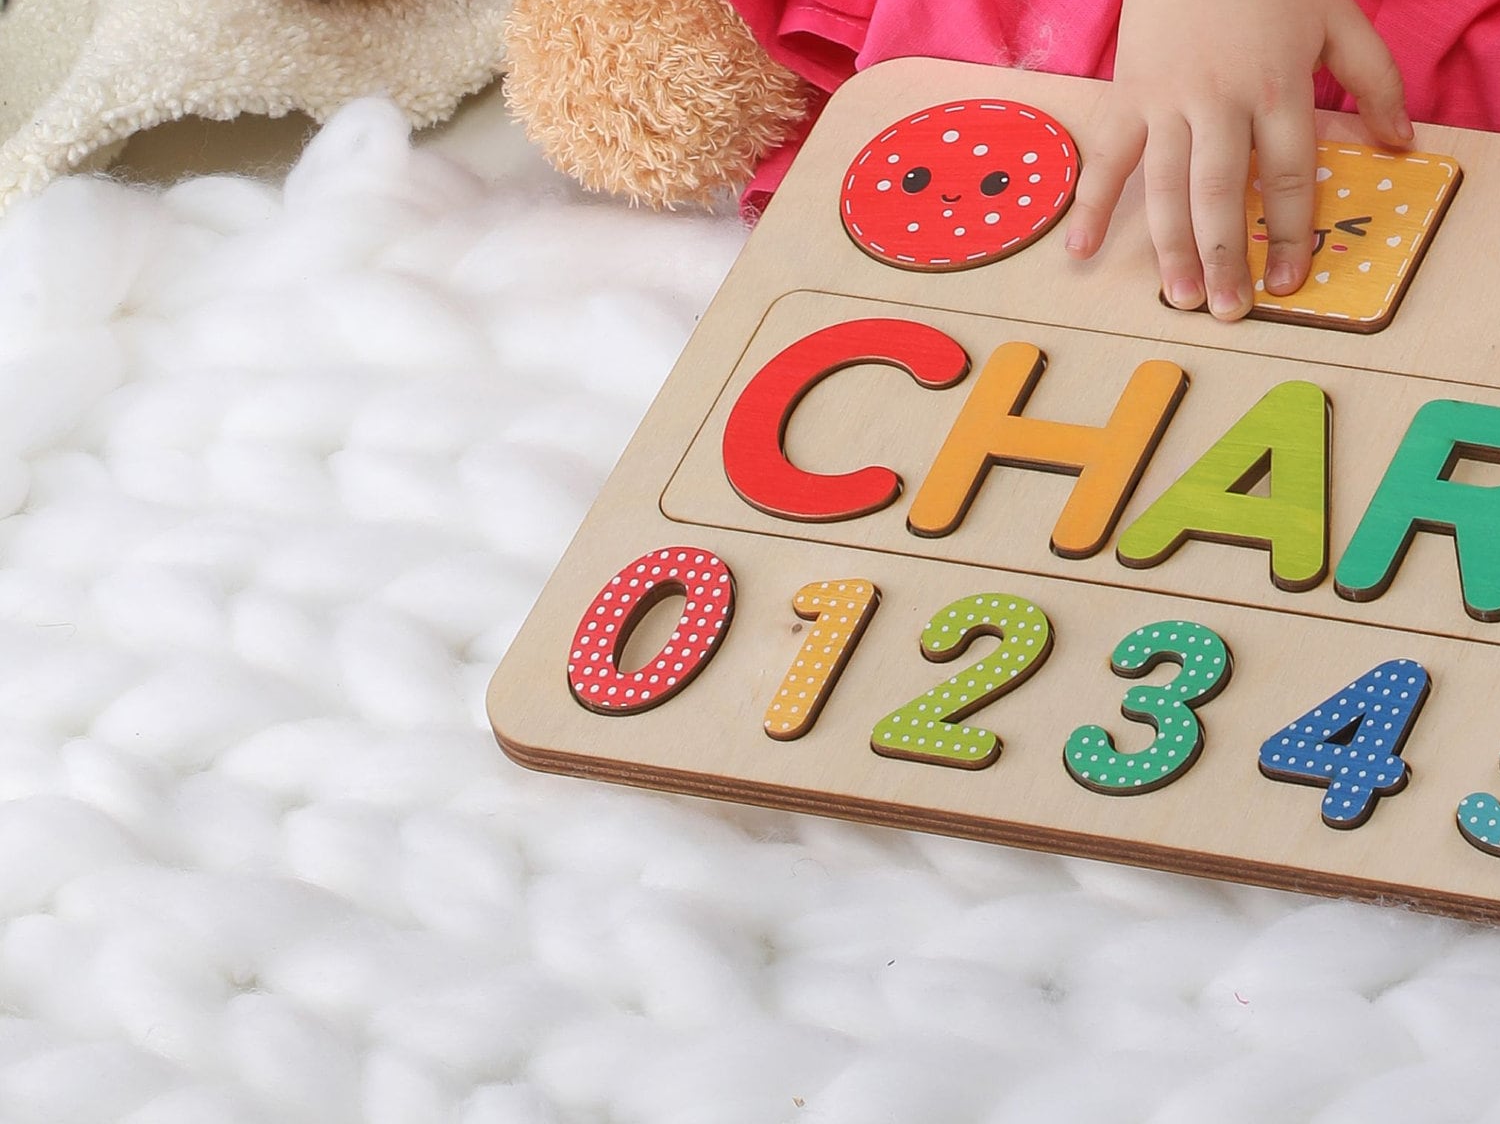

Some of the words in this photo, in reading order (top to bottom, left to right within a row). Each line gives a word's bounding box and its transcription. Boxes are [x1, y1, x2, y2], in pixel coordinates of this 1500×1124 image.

[567, 545, 738, 716] 0
[764, 578, 880, 742] 1
[870, 593, 1053, 770] 2
[1064, 620, 1232, 796] 3
[1258, 658, 1433, 831] 4
